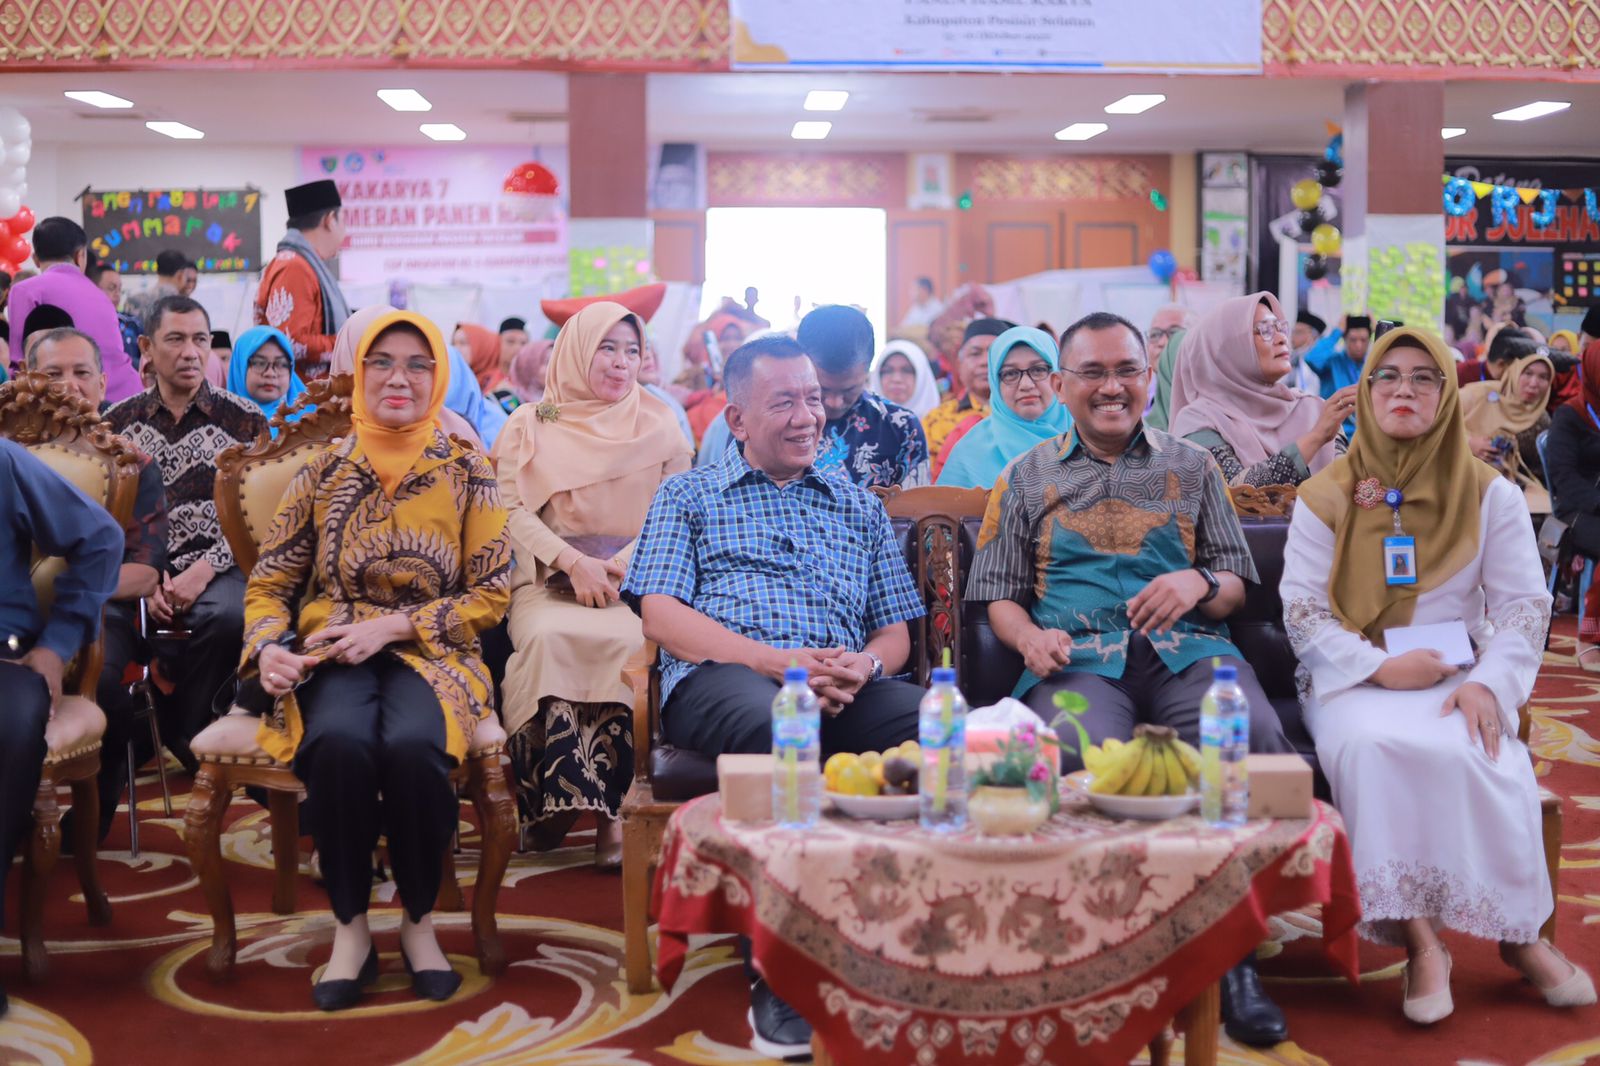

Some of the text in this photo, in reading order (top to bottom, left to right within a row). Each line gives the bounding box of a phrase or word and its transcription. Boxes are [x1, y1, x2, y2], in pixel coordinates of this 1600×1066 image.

[338, 178, 451, 200] KAKARYA 7
[342, 205, 416, 227] MERAN
[423, 203, 491, 225] PANEN
